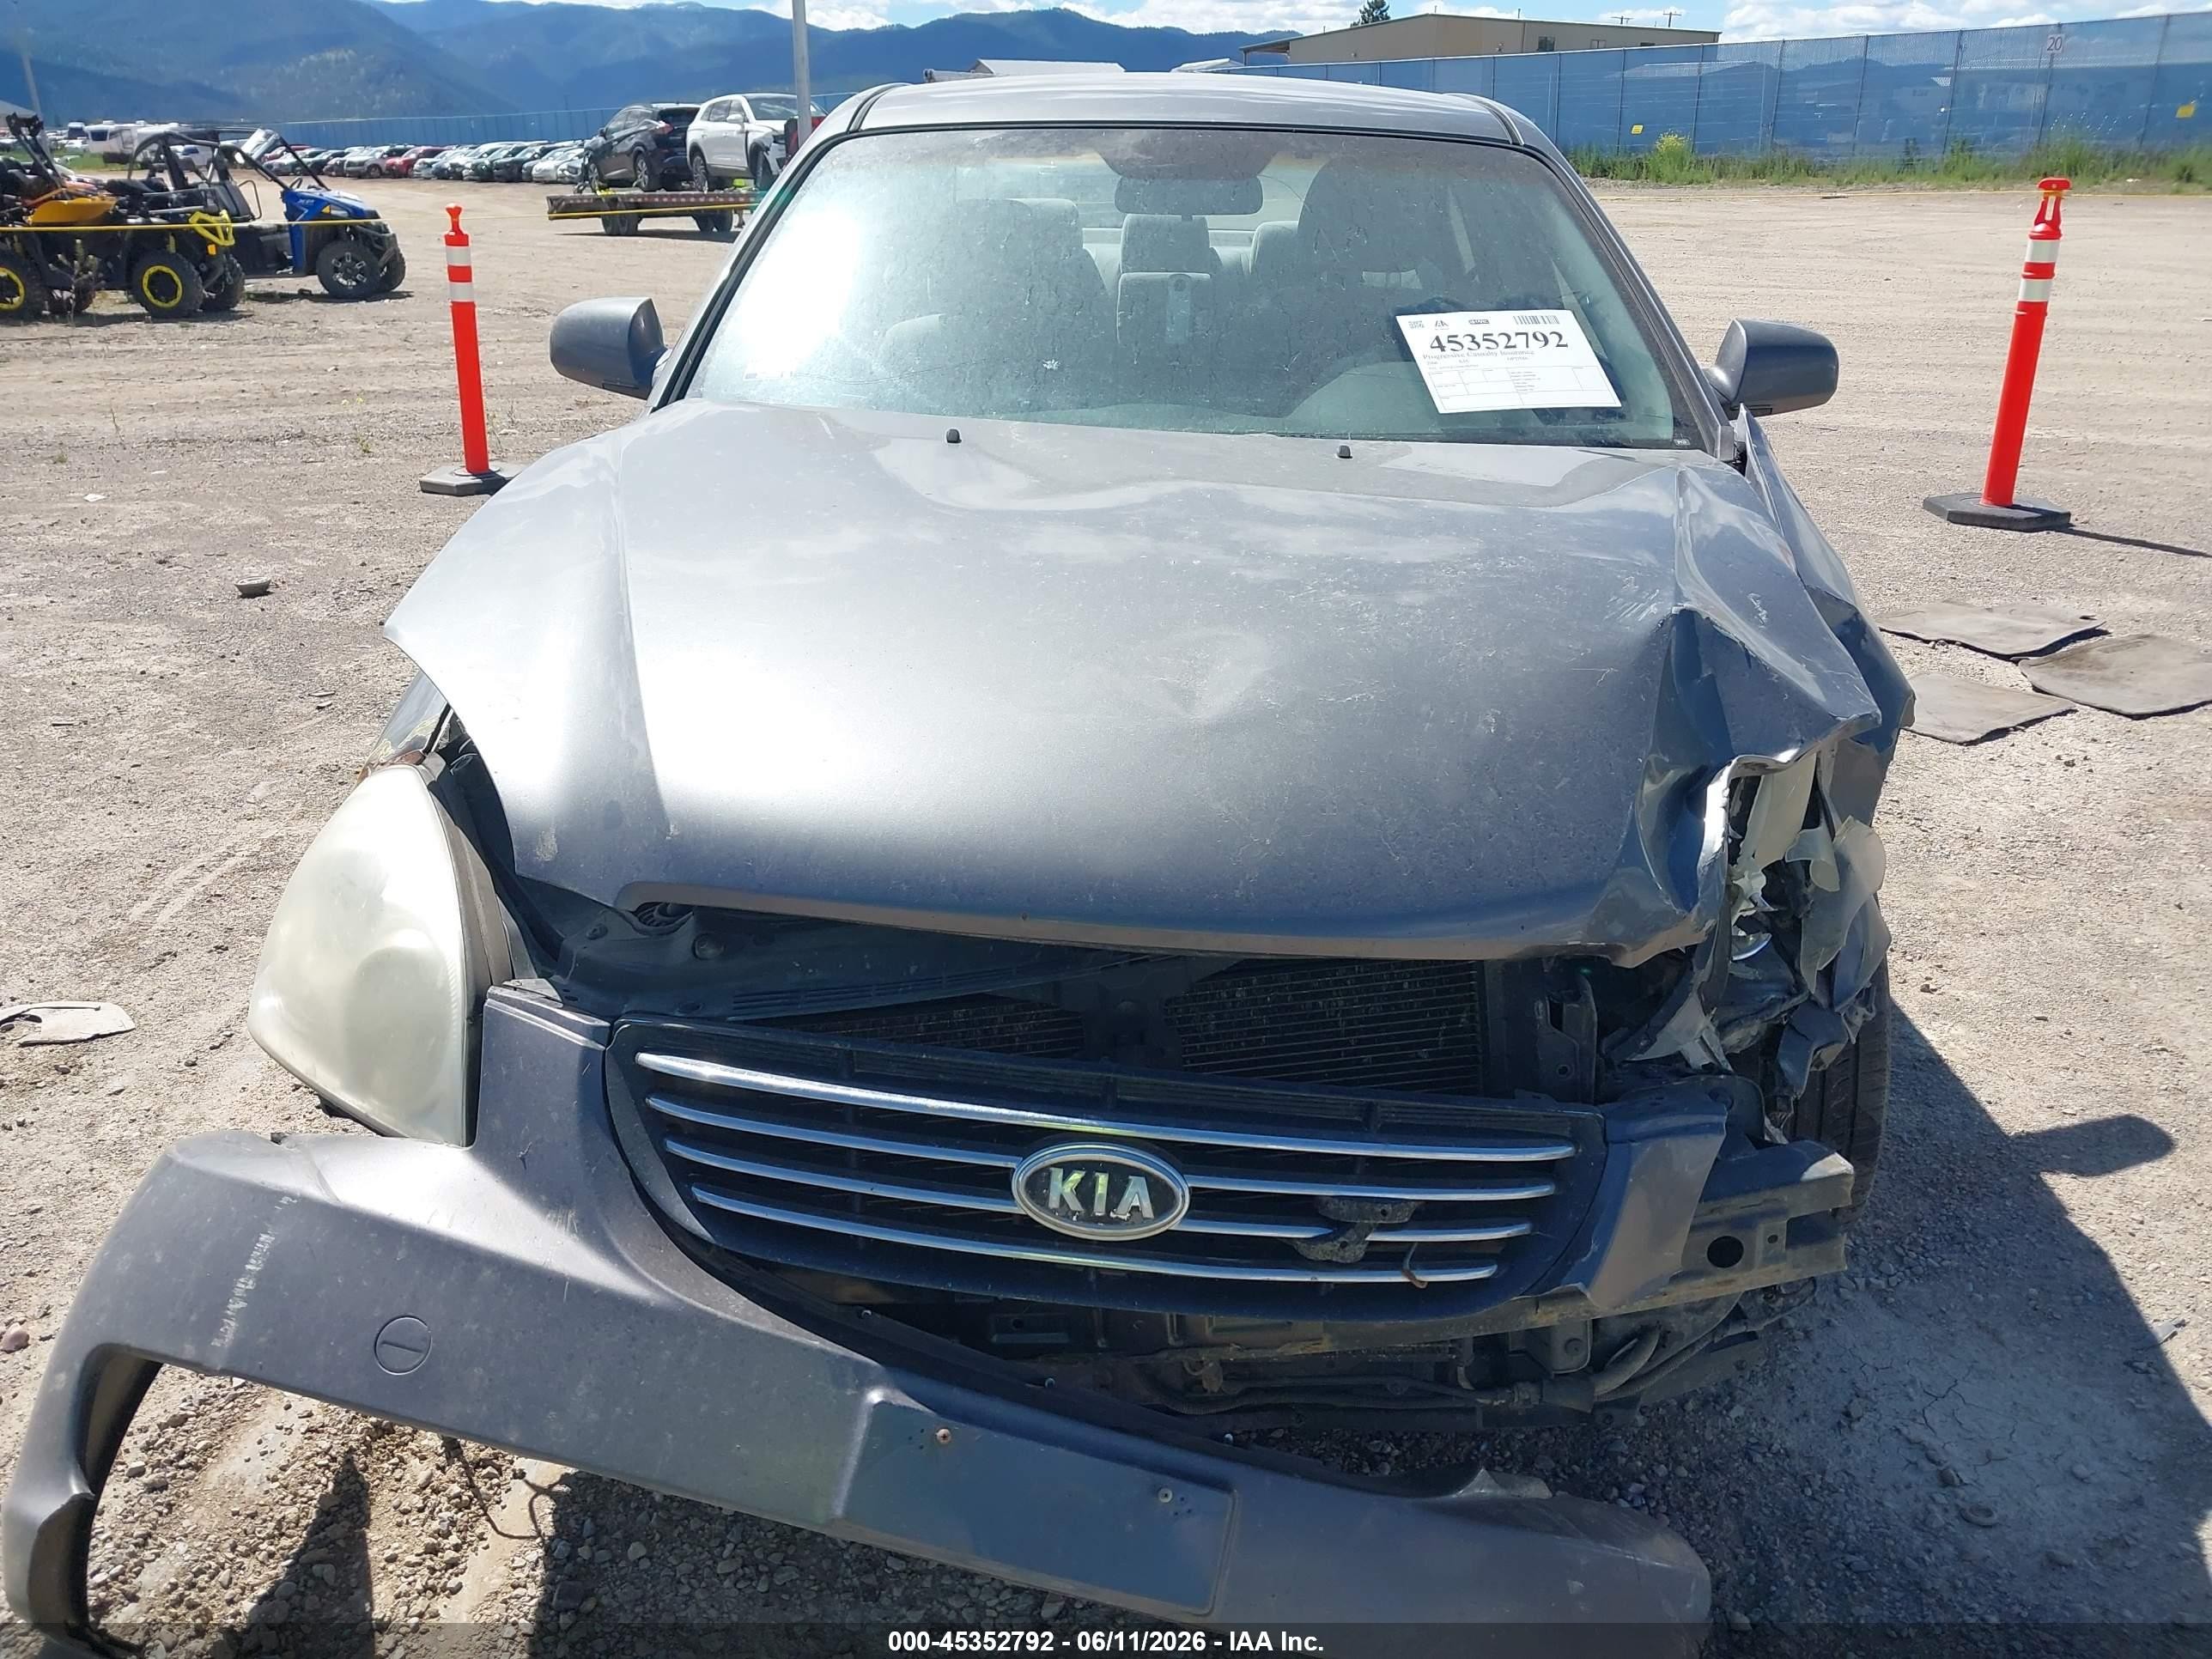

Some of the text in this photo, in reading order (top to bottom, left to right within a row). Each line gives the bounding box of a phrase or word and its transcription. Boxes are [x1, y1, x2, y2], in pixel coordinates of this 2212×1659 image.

[2047, 36, 2063, 51] 20
[1430, 331, 1569, 352] 45352792
[1048, 1167, 1155, 1218] KIA
